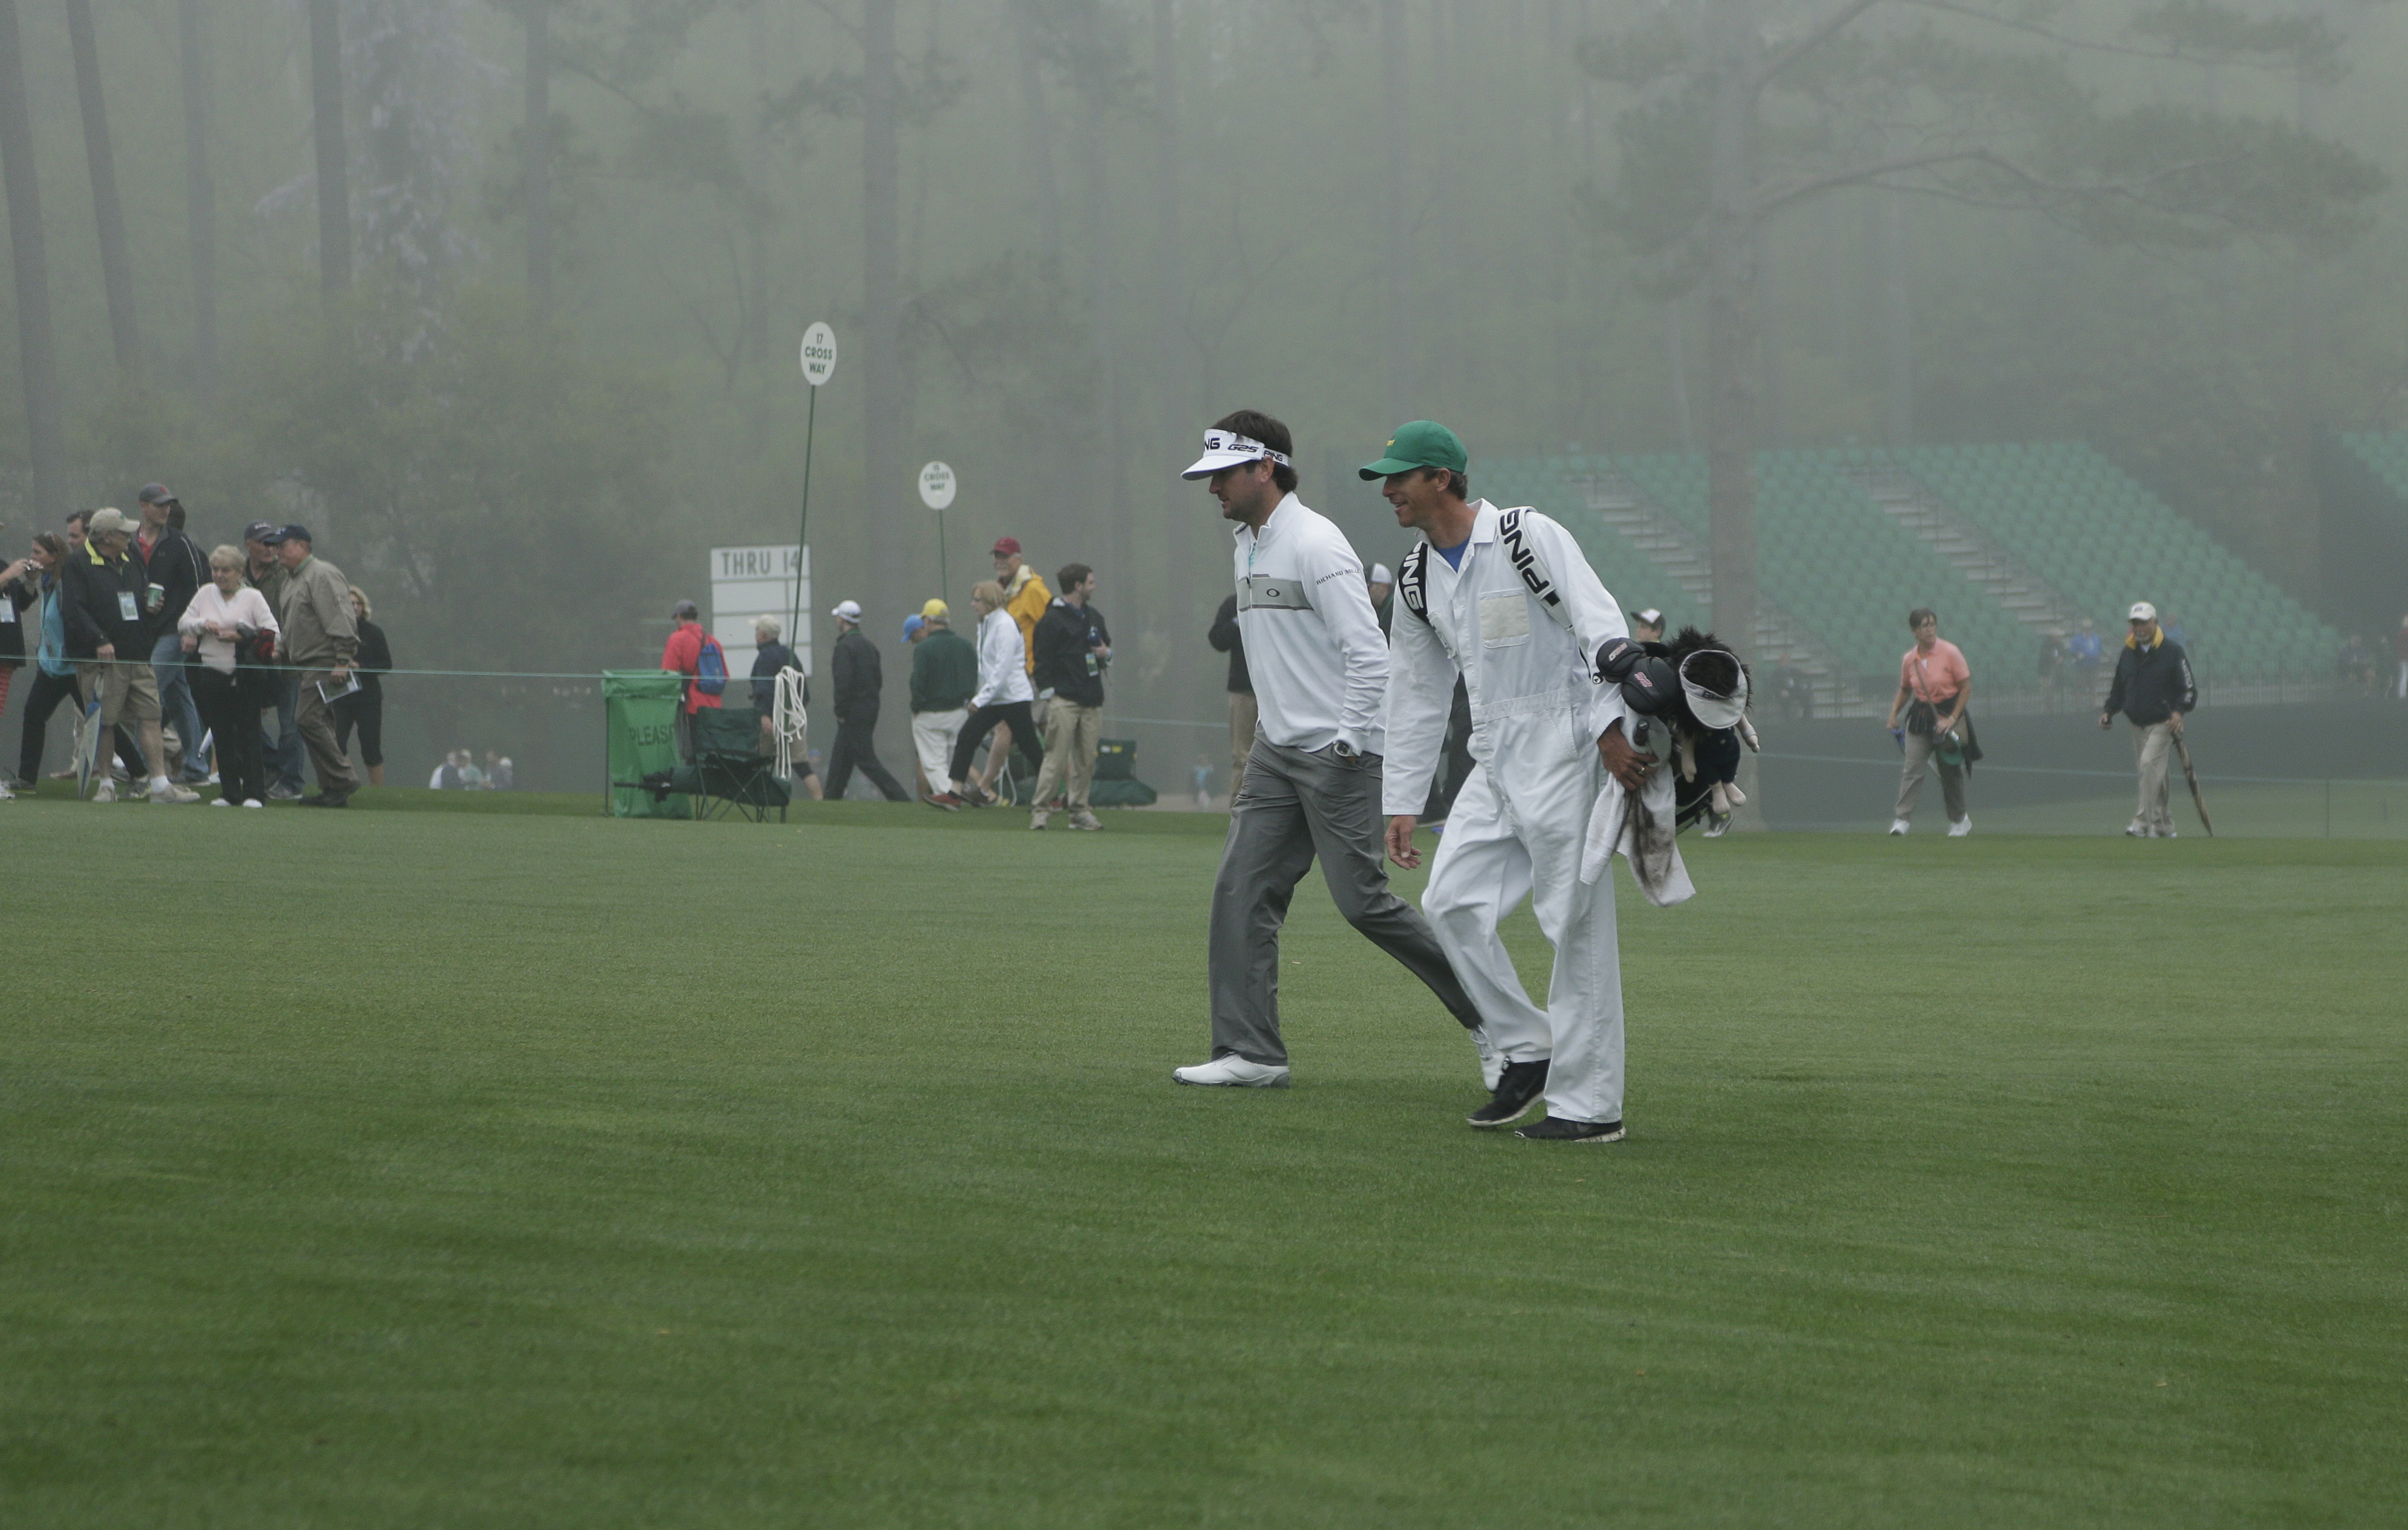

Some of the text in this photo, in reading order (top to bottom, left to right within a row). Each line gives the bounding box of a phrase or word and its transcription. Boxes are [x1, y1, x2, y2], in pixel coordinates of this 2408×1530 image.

[817, 332, 824, 344] 17
[805, 346, 832, 360] CROSS
[810, 362, 826, 374] WAY
[1228, 443, 1259, 452] G25
[1264, 450, 1283, 462] PING
[1500, 508, 1550, 594] PING
[722, 549, 801, 576] THRU 14
[1316, 570, 1343, 585] RICHARD
